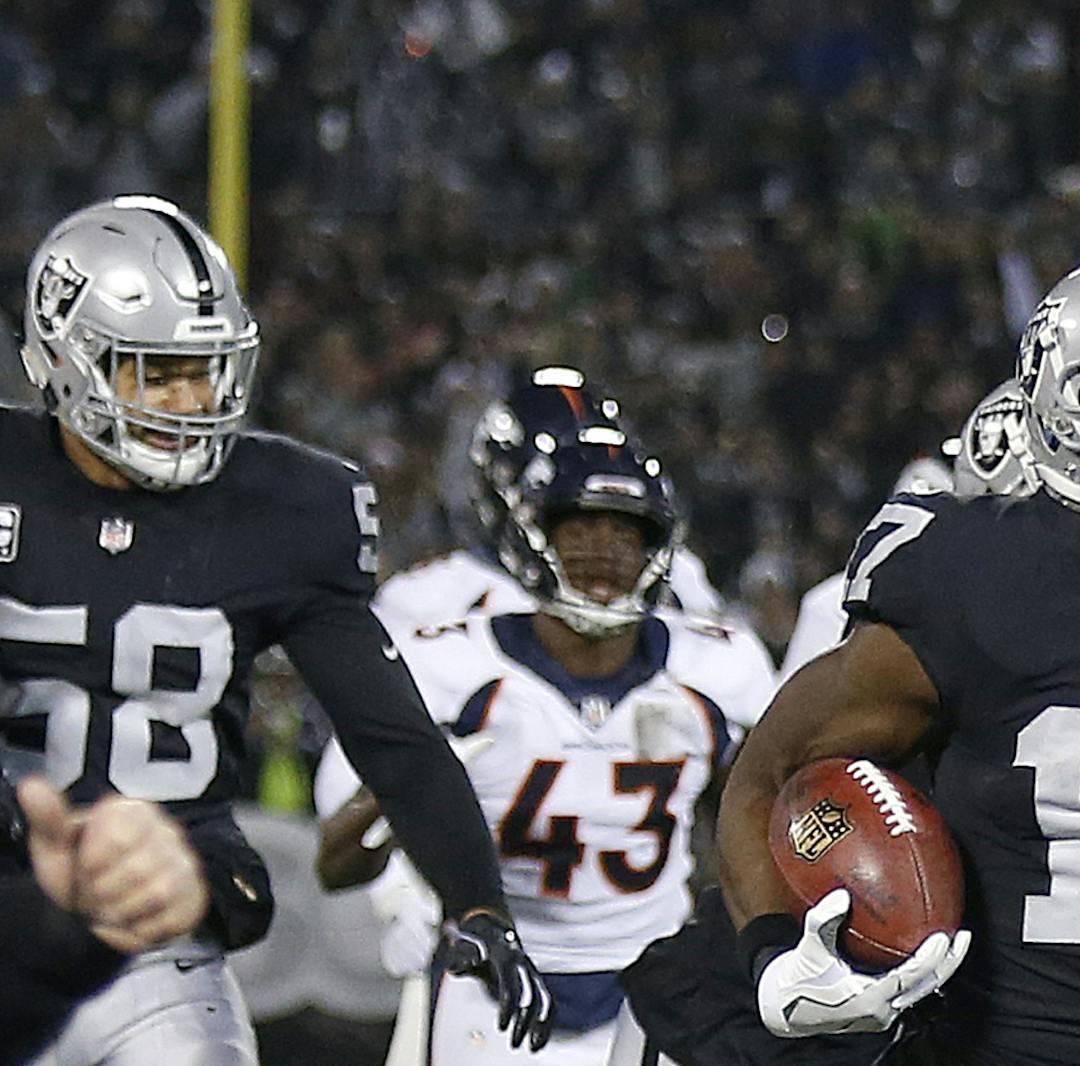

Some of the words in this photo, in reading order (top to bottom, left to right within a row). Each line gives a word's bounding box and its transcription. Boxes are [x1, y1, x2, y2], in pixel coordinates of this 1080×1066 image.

[0, 597, 235, 802] 58
[497, 757, 687, 900] 43
[792, 811, 834, 859] NFL
